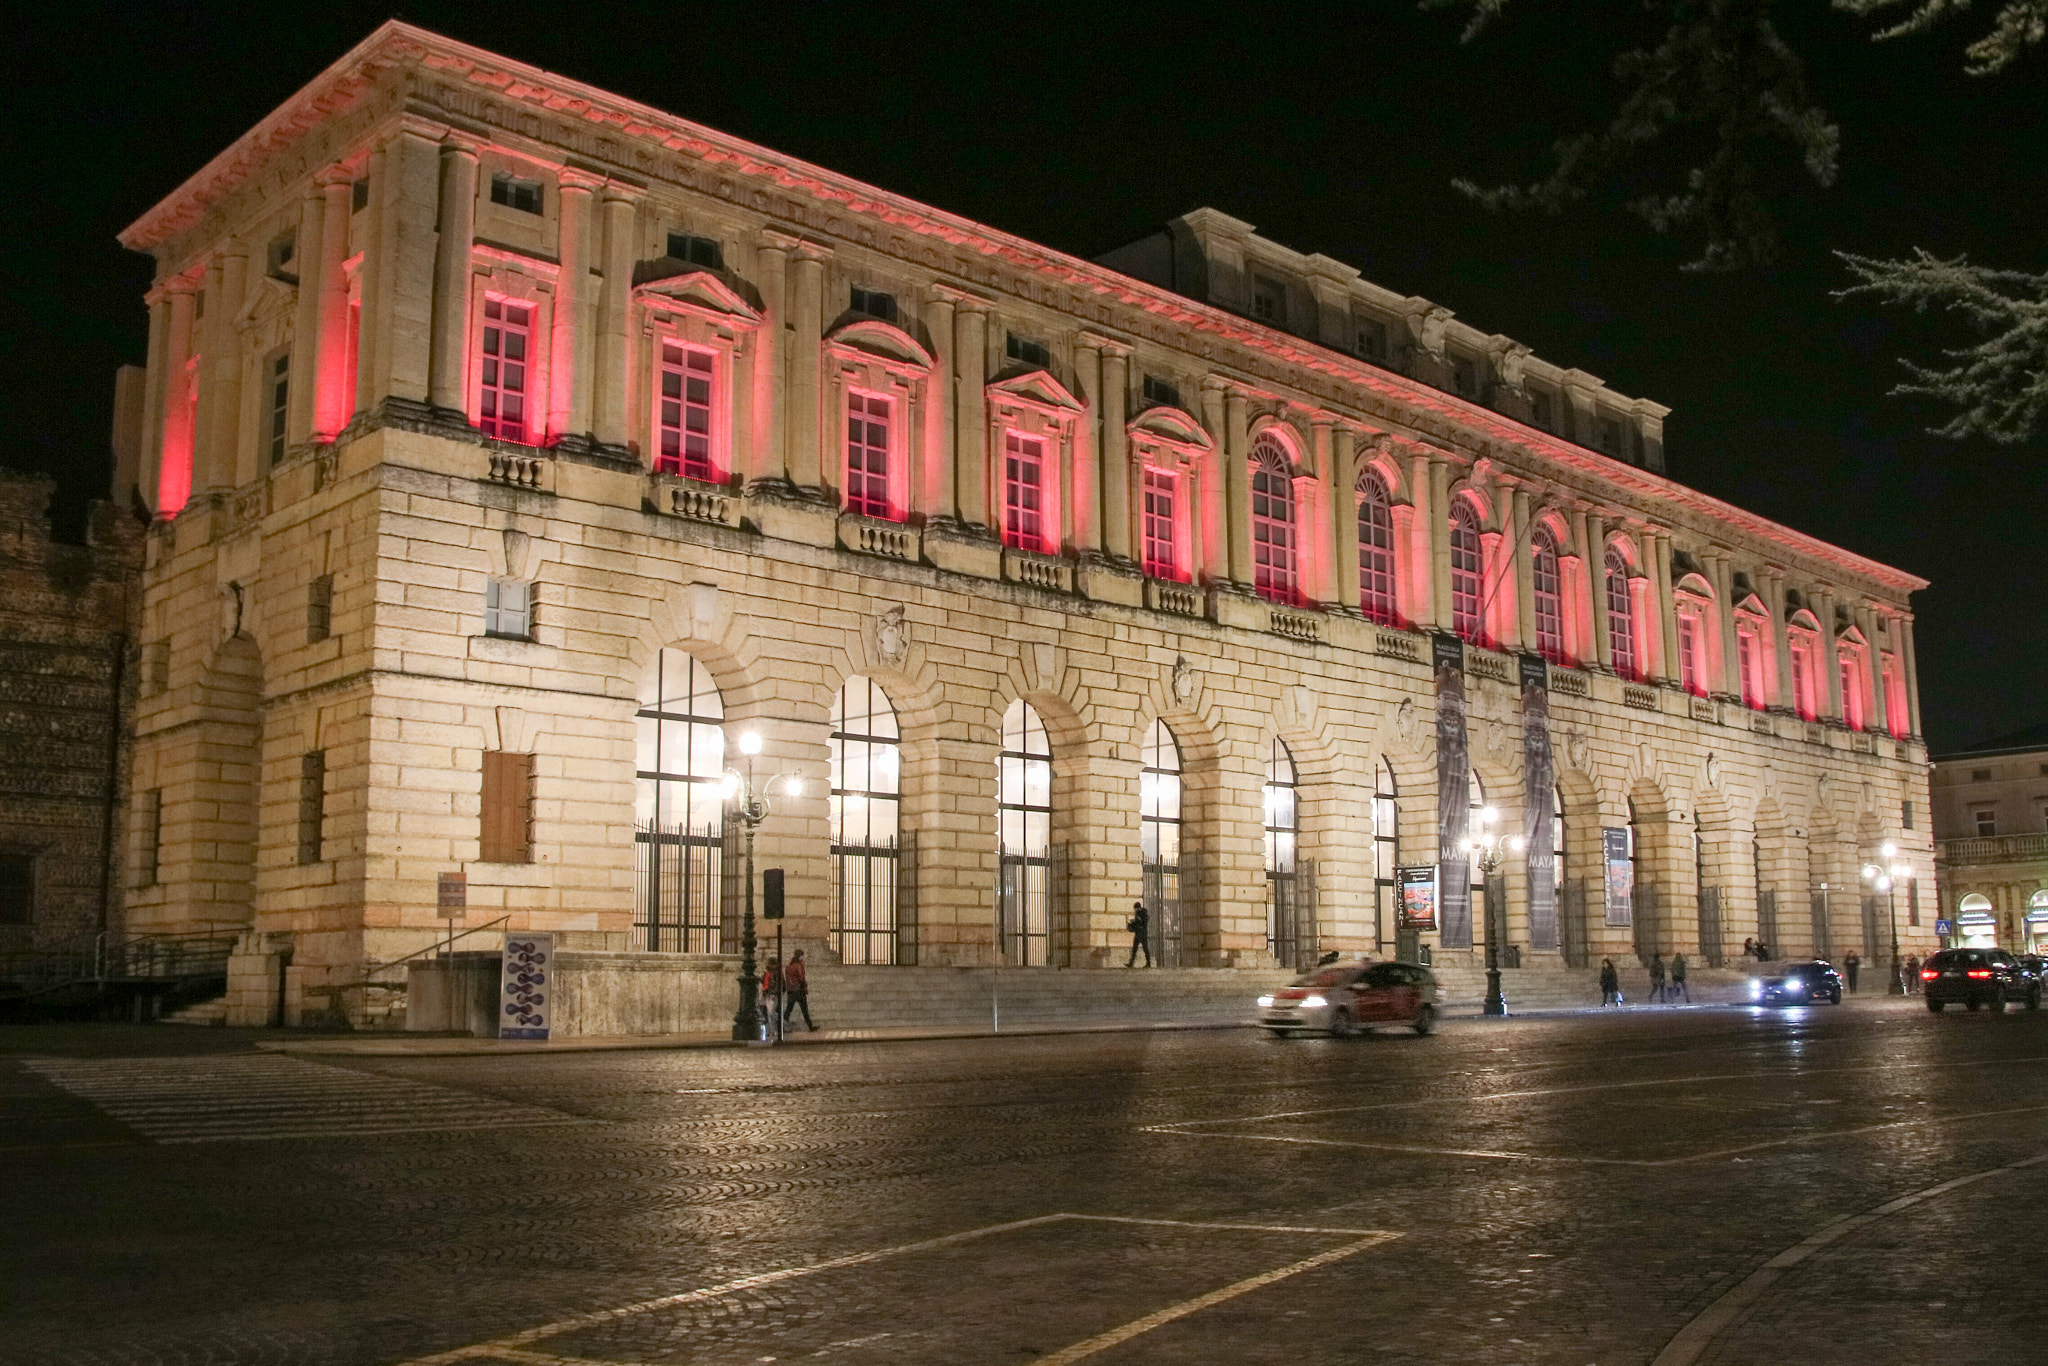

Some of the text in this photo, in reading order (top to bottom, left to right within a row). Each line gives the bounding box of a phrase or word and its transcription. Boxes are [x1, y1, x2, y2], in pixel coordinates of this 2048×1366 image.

[1441, 847, 1468, 860] MAYA
[1528, 855, 1554, 868] MAYA
[1603, 830, 1611, 918] FACCINCANI
